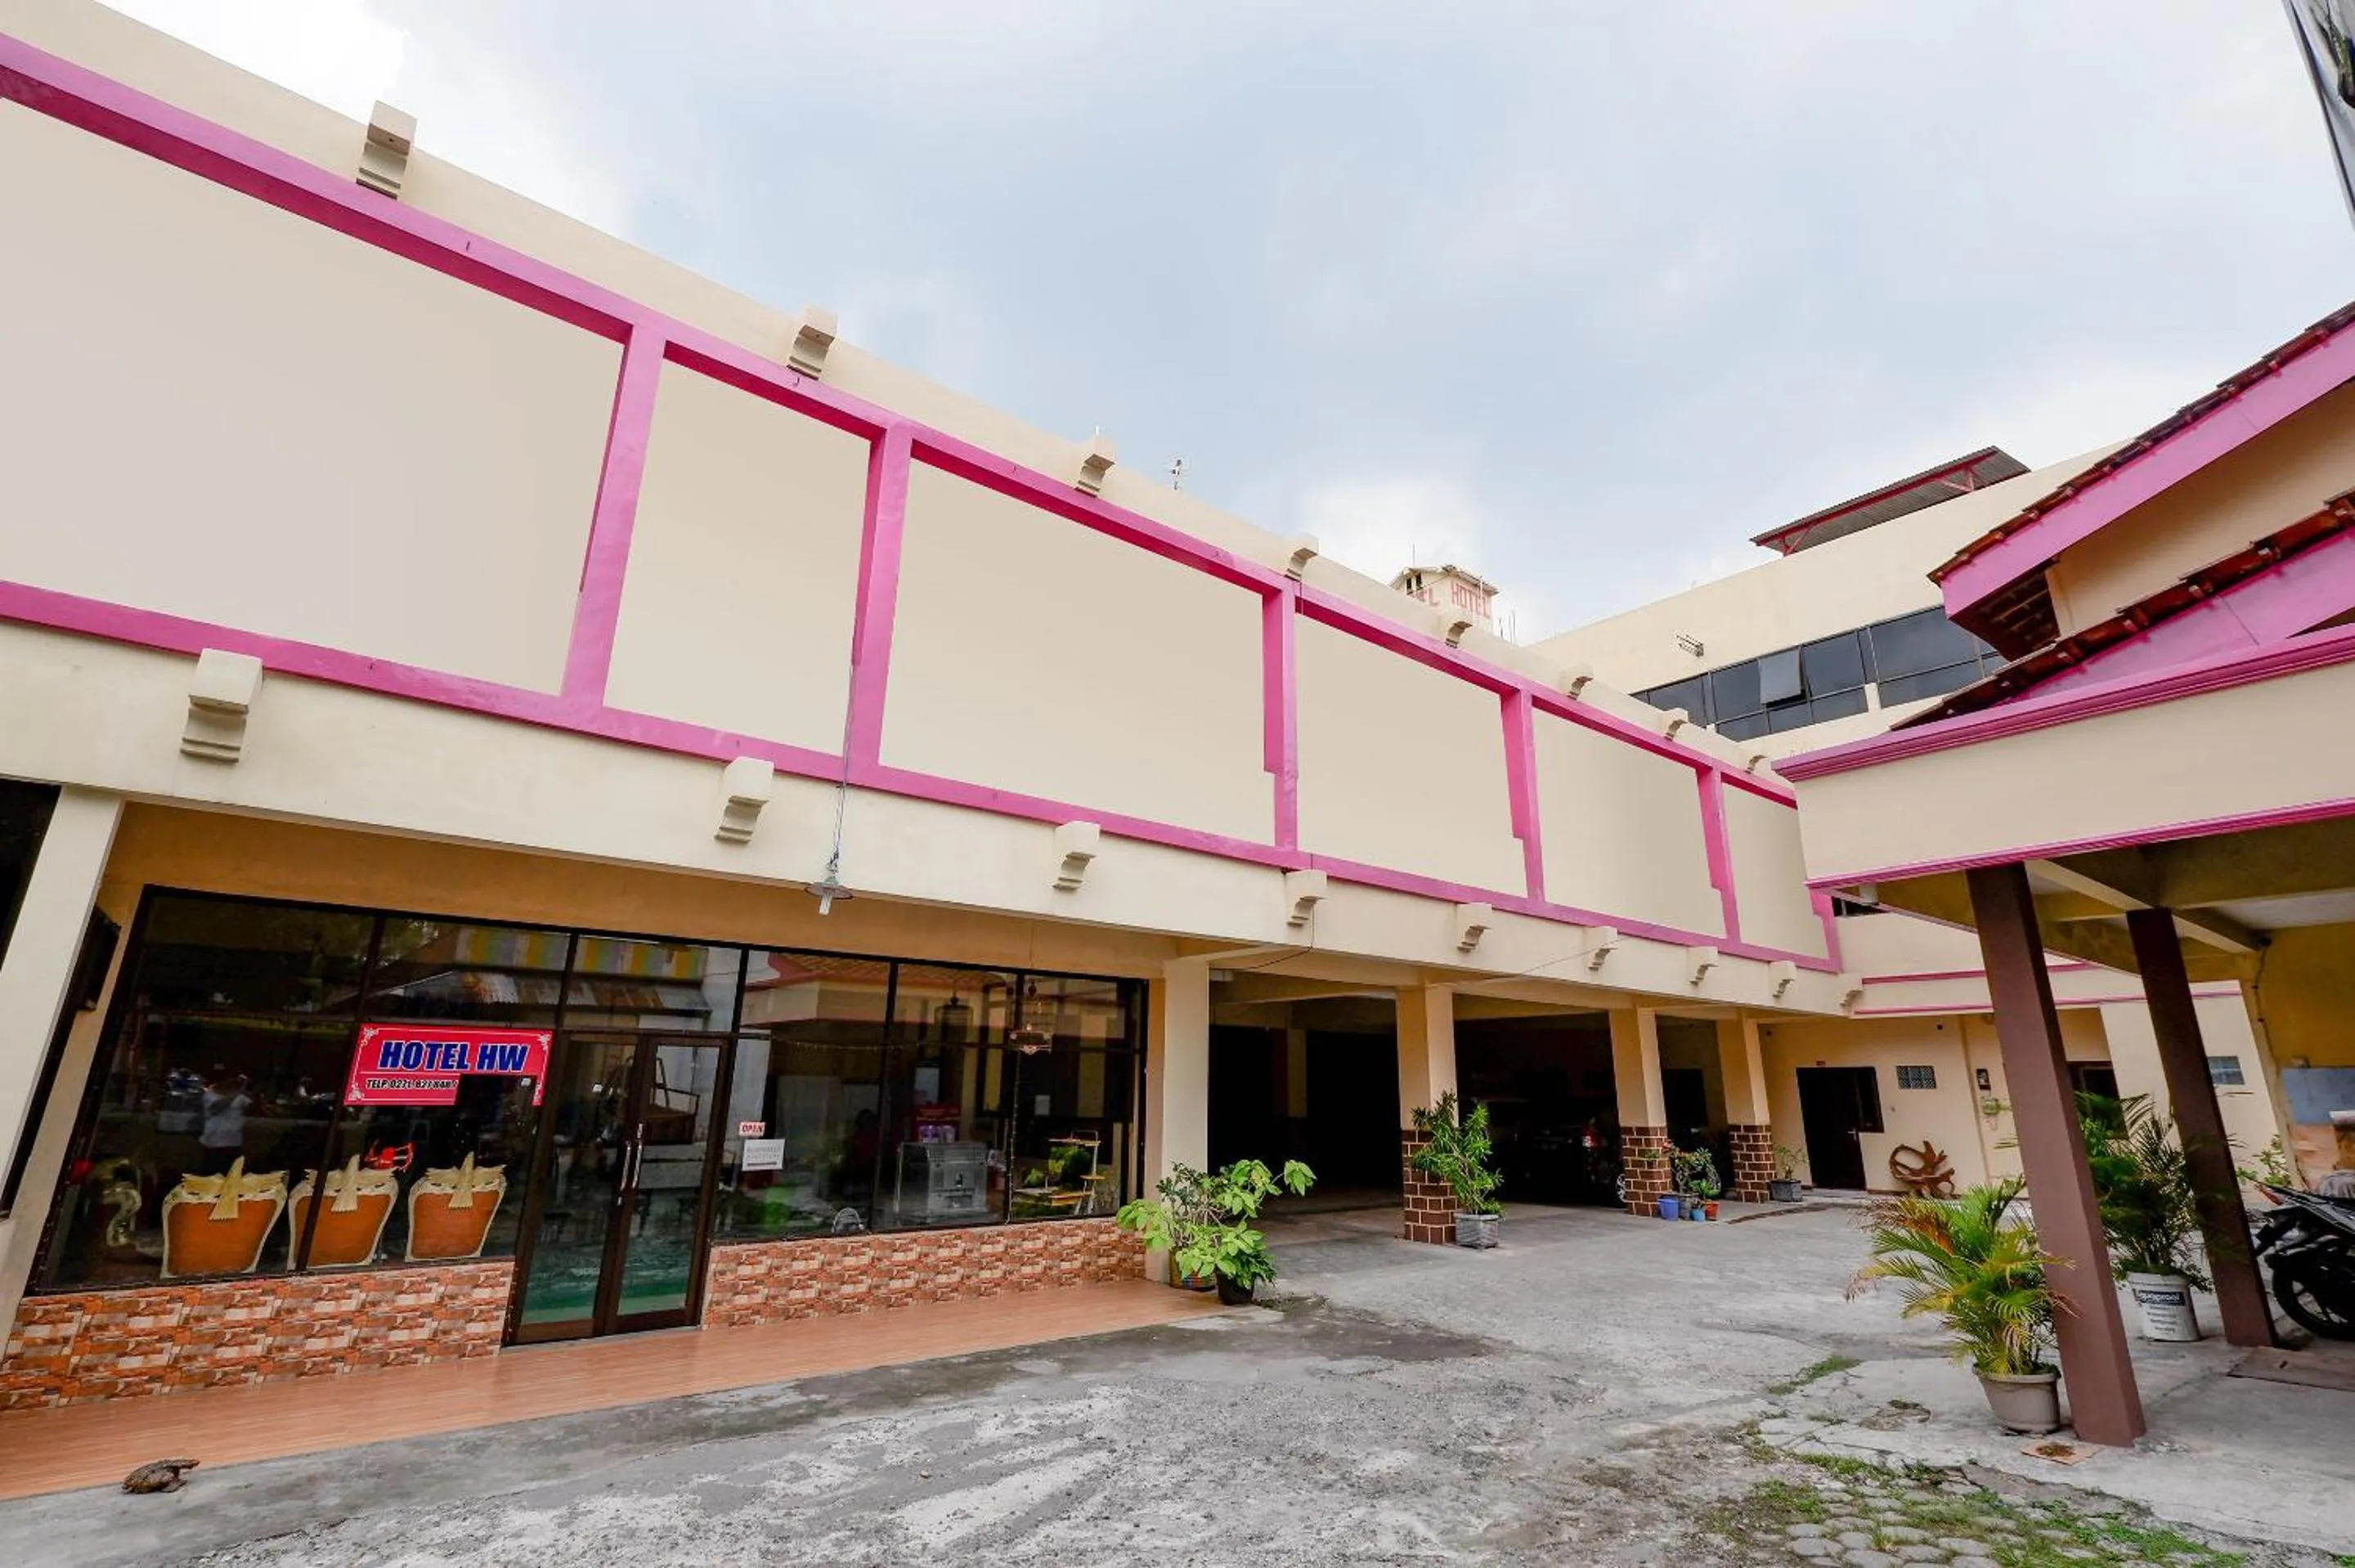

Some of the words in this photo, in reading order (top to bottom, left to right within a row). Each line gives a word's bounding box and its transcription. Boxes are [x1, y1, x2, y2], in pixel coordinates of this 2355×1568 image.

[1451, 581, 1491, 619] HOTEL
[378, 1040, 470, 1072] HOTEL
[476, 1043, 530, 1073] HW
[742, 1124, 762, 1133] OPEN
